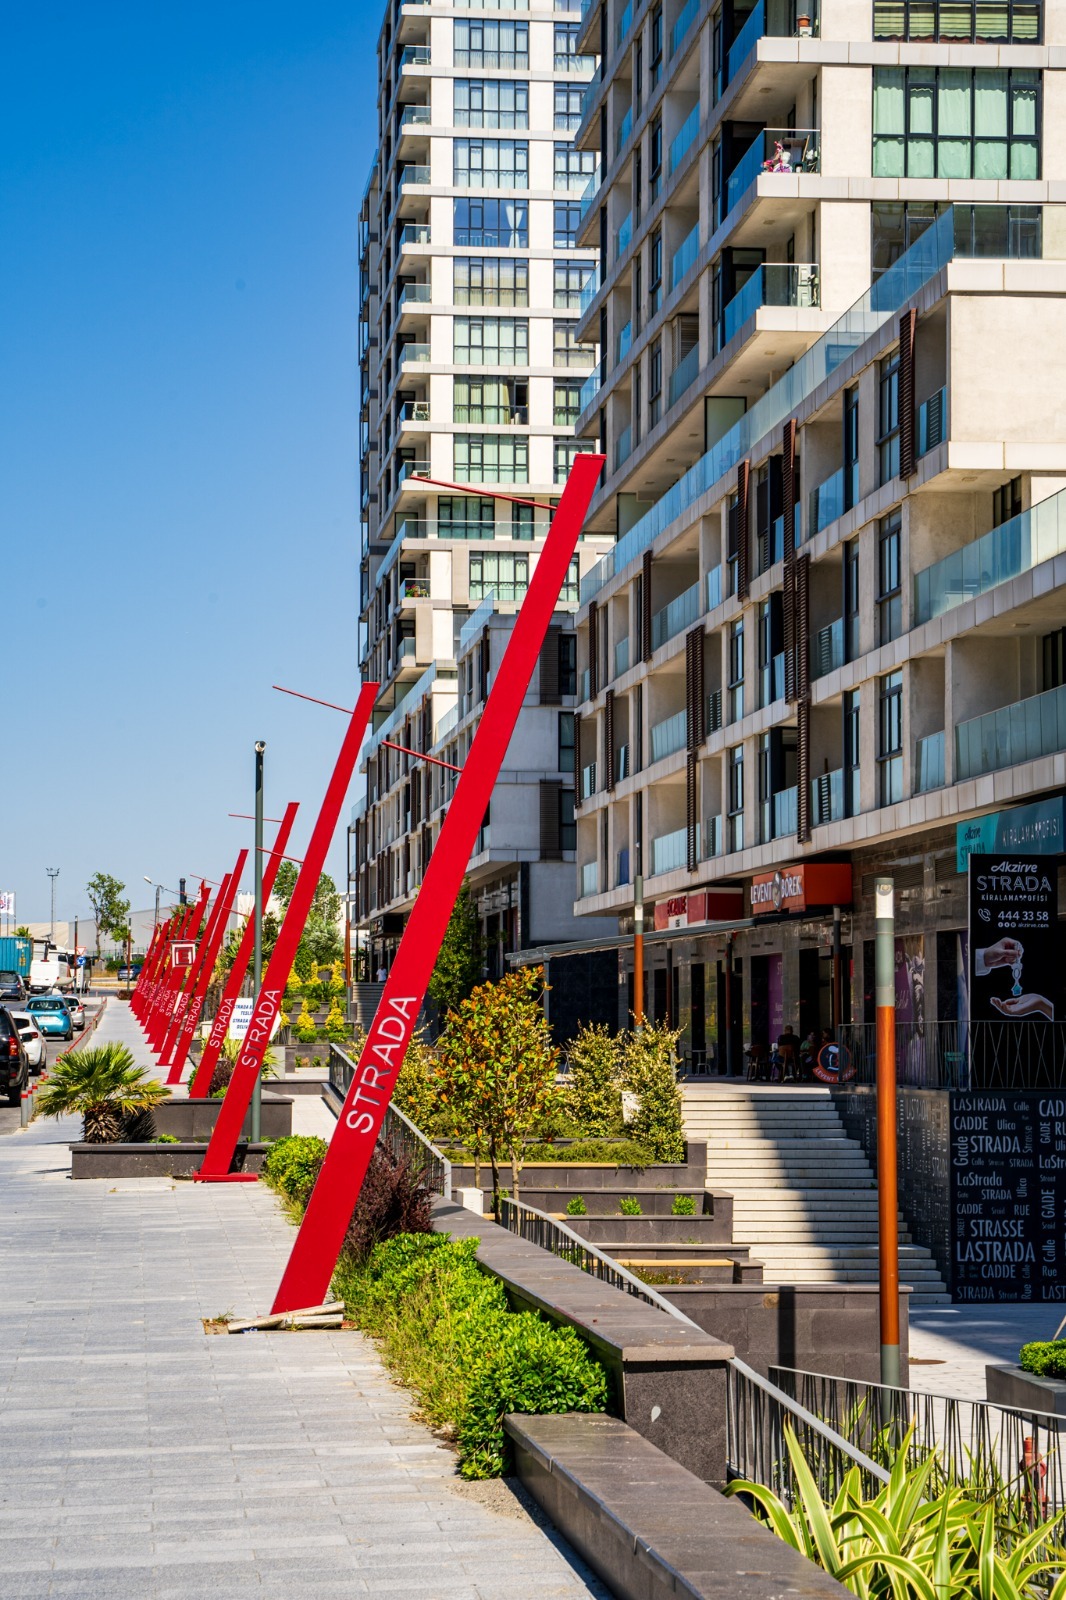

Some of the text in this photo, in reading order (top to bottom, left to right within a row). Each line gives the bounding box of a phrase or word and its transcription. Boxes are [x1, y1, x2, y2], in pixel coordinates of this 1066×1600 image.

[990, 861, 1038, 873] Akzirve
[750, 873, 803, 905] LEVENT BÖREK
[976, 875, 1052, 892] STRADA
[981, 892, 1048, 903] KİRALAMA OFİSİ
[997, 910, 1049, 922] 444 33 58
[1017, 921, 1050, 929] akzirve.com
[174, 992, 191, 1024] STRADA
[184, 995, 204, 1034] STRADA
[209, 998, 235, 1048] STRADA
[241, 989, 281, 1068] STRADA
[345, 996, 417, 1134] STRADA
[953, 1097, 1007, 1112] LASTRADA
[1013, 1101, 1030, 1111] Calle
[1039, 1099, 1066, 1117] CAD
[953, 1116, 989, 1131] CADDE
[996, 1118, 1016, 1130] Ulica
[1039, 1121, 1051, 1144] GADE
[952, 1135, 969, 1166] Gade
[970, 1135, 1021, 1154] STRADA
[1009, 1158, 1034, 1168] STRADA
[956, 1170, 1003, 1187] LaStrada
[980, 1188, 1012, 1201] STRADA
[1015, 1177, 1028, 1198] Ulica
[956, 1203, 984, 1215] CADDE
[1013, 1204, 1030, 1216] RUE
[1041, 1188, 1056, 1219] GADE
[970, 1219, 1025, 1238] STRASSE
[956, 1240, 1036, 1263] LASTRADA
[1041, 1239, 1056, 1263] Calle
[981, 1264, 1017, 1279] CADDE
[1042, 1265, 1058, 1277] Rue
[956, 1286, 995, 1300] STRADA
[1020, 1283, 1032, 1300] Rue
